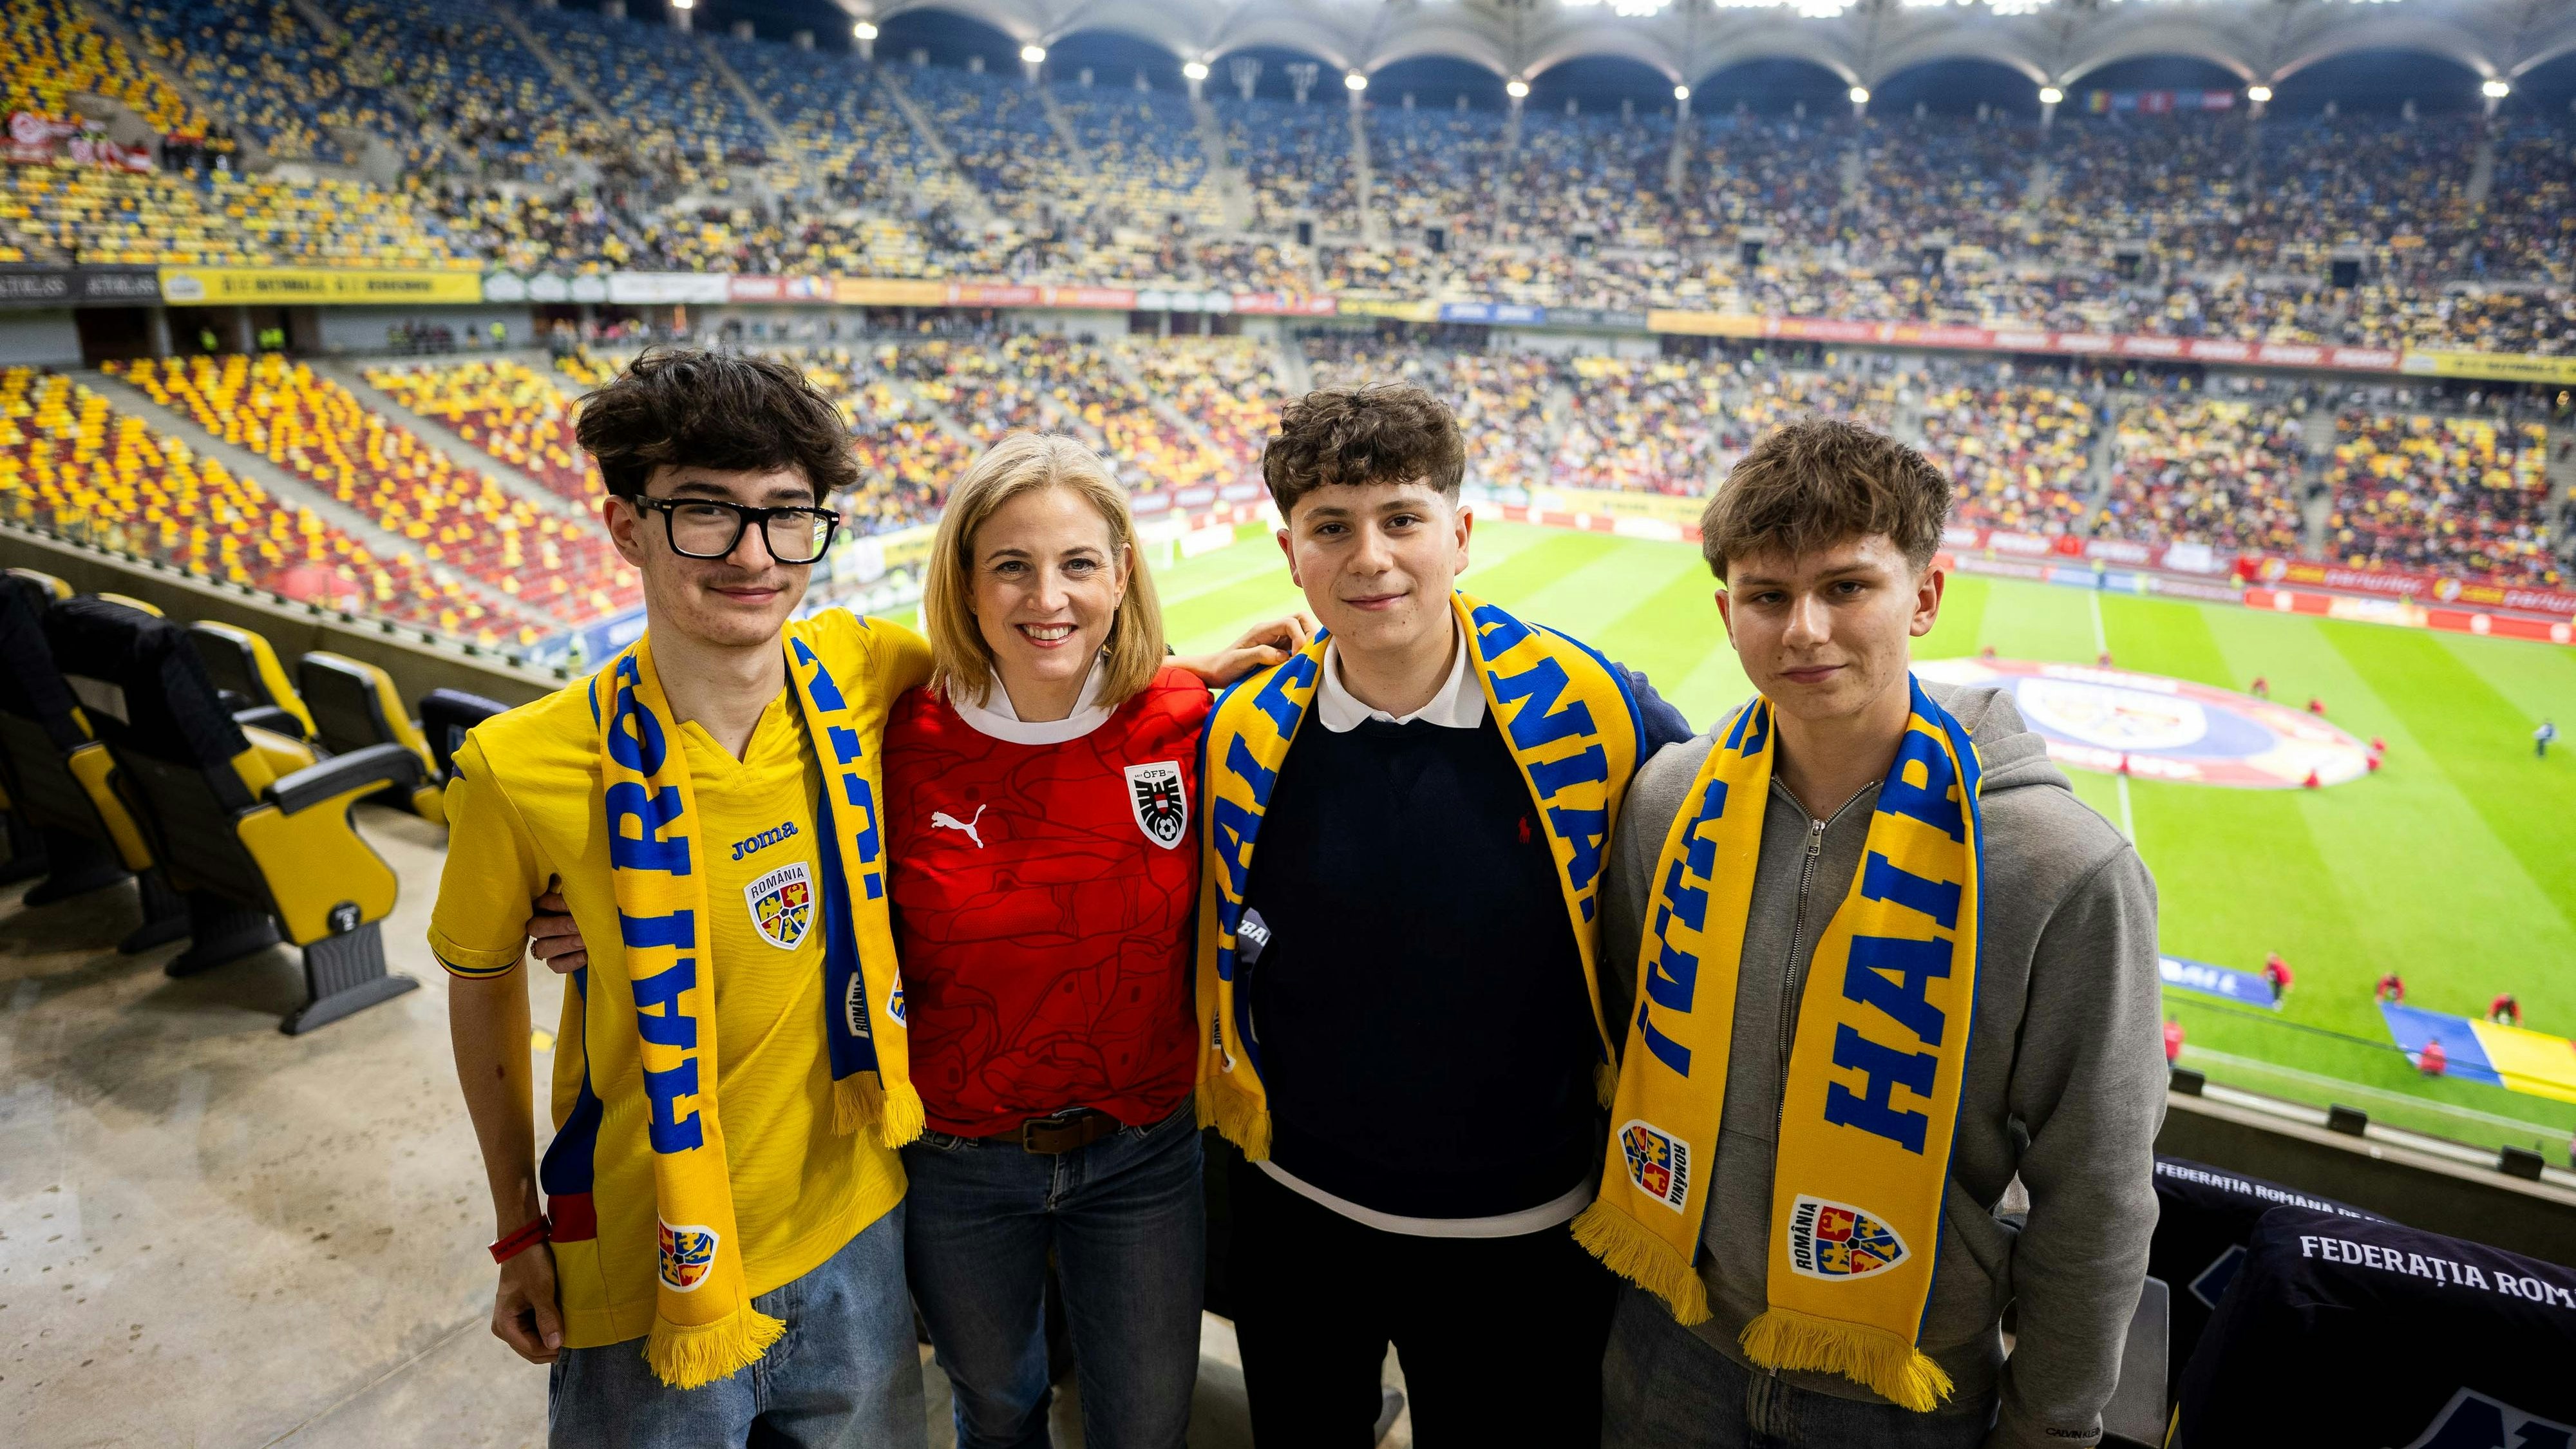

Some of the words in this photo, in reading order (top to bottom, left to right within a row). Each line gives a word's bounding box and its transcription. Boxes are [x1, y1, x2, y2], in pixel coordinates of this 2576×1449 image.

[1143, 769, 1166, 779] ÖFB
[751, 867, 804, 899] ROMÂNIA
[1824, 850, 1963, 1155] HAI
[1669, 1142, 1688, 1206] ROMÂNIA
[1791, 1203, 1817, 1271] ROMÂNIA
[2300, 1236, 2490, 1290] FEDERAȚIA
[2494, 1271, 2576, 1309] ROM
